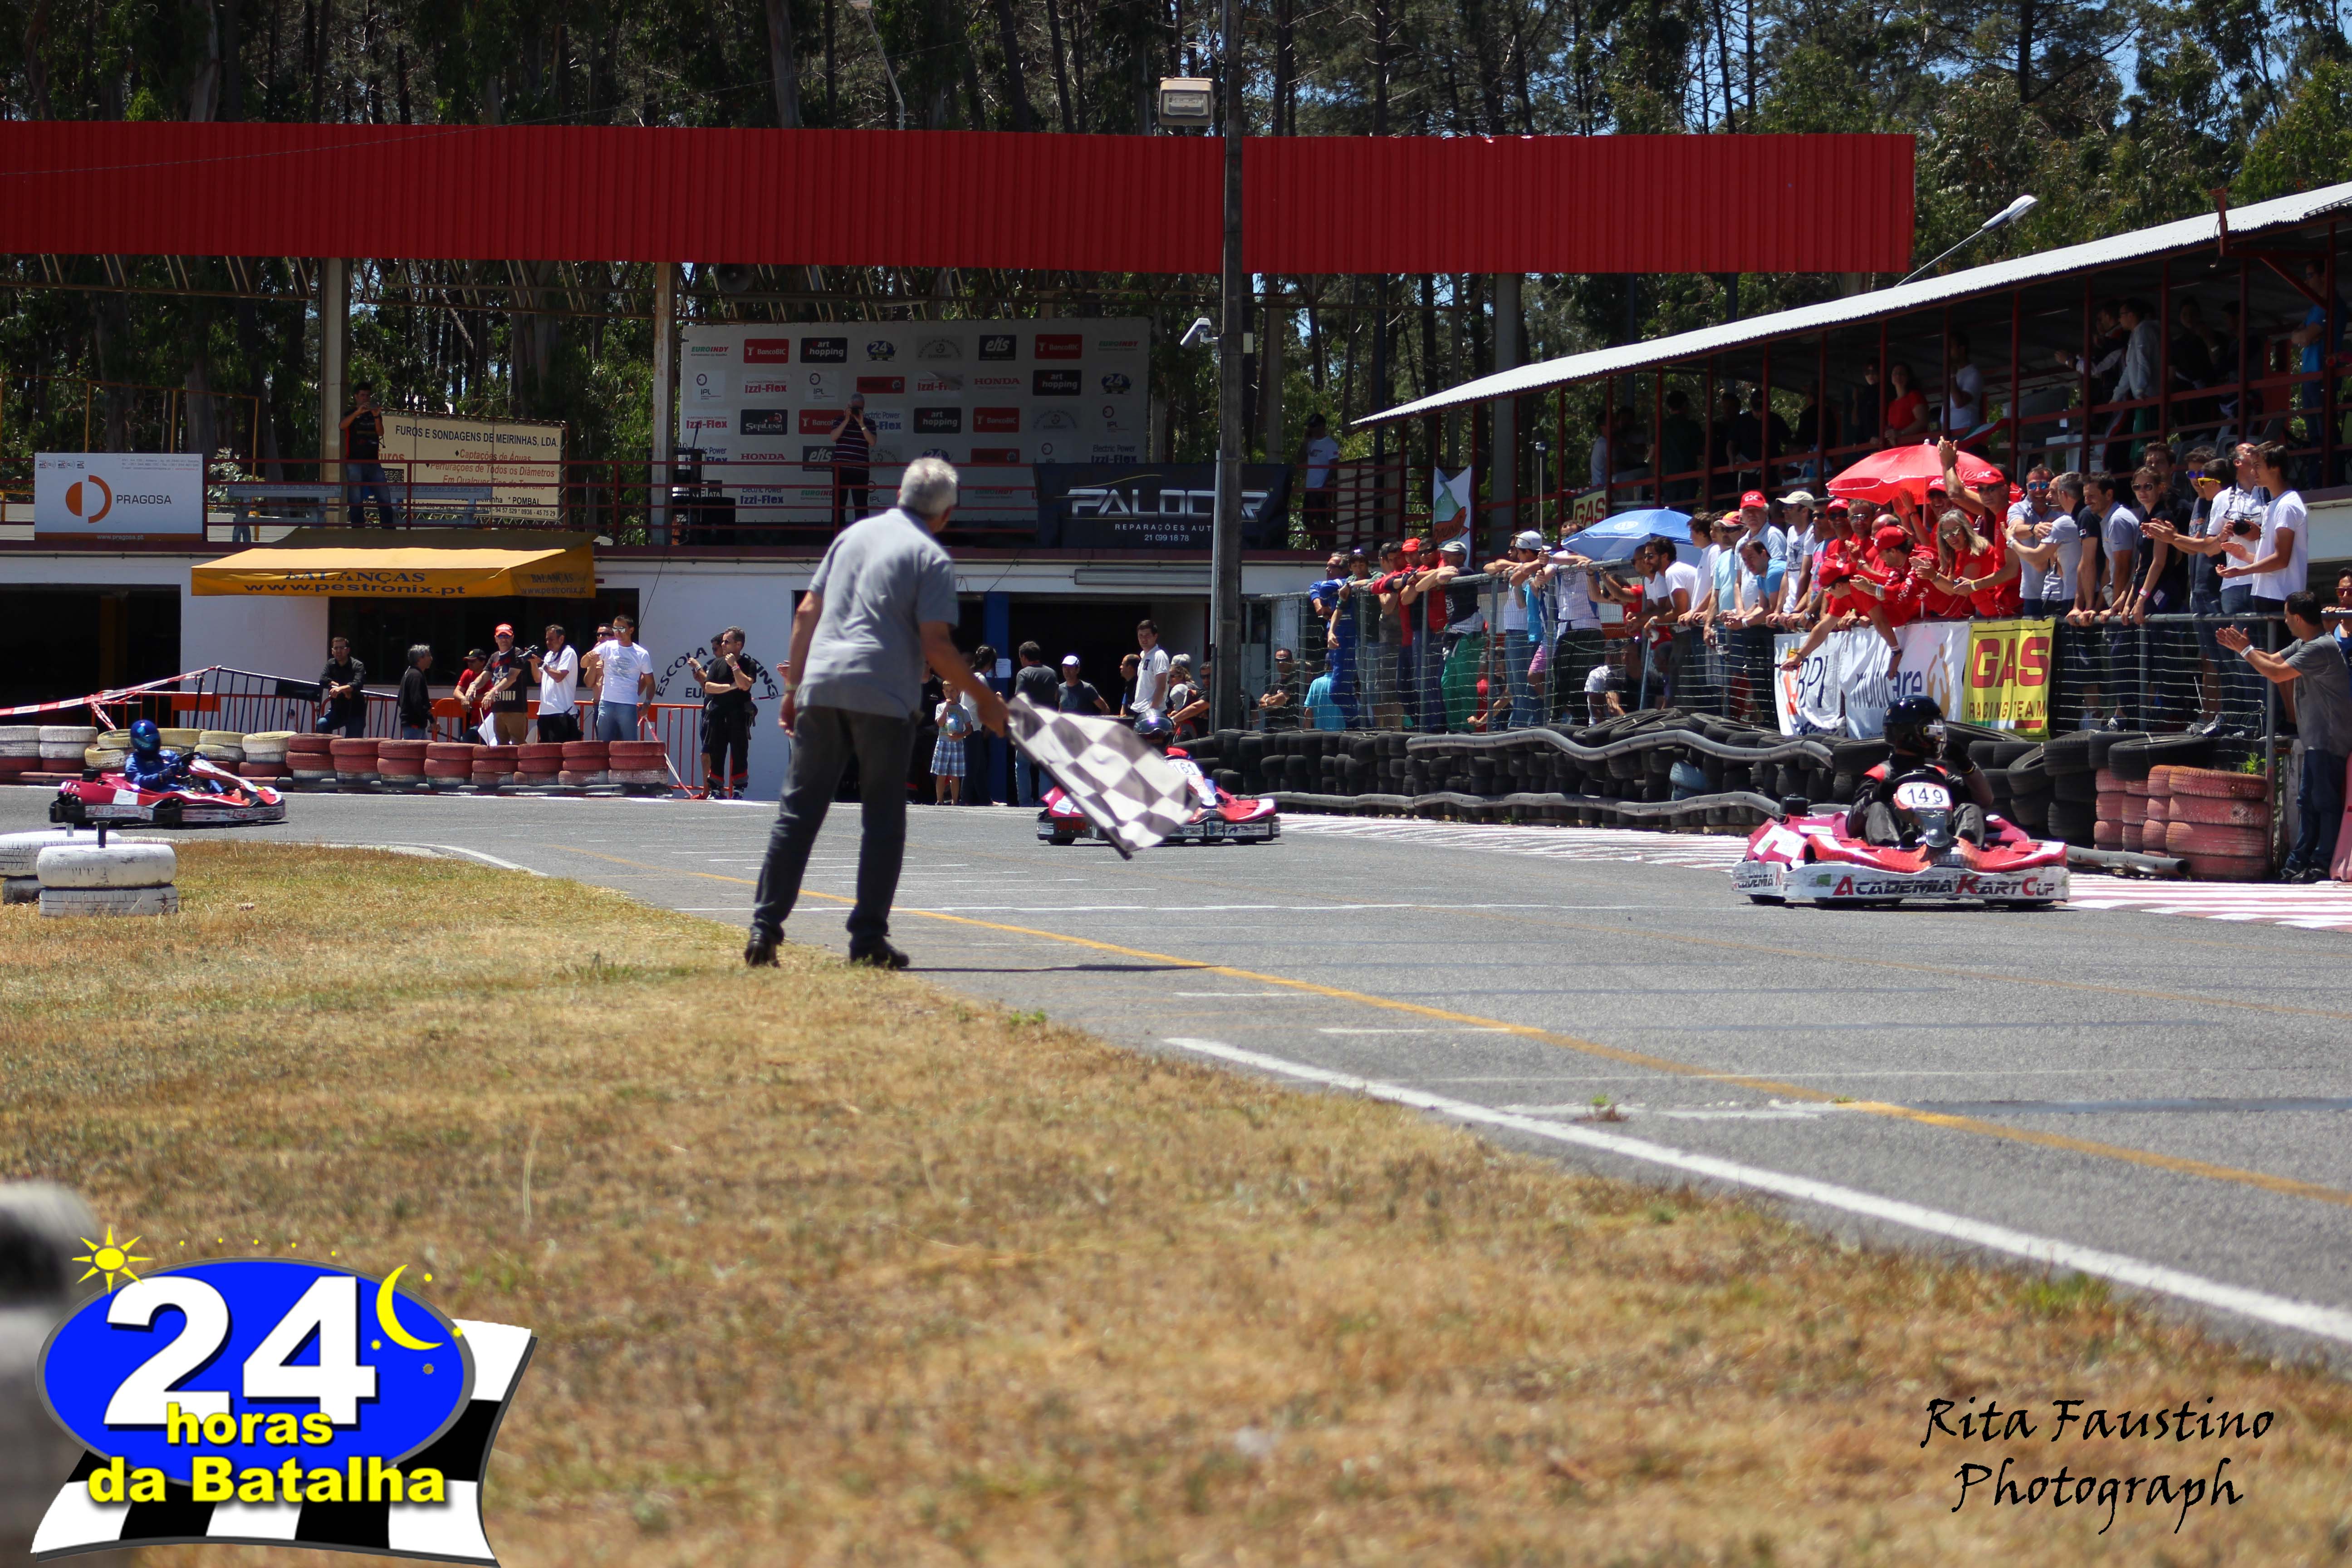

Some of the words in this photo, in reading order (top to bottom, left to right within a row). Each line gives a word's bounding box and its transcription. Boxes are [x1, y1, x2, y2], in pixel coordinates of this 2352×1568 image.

[396, 425, 422, 437] FUROS
[426, 428, 430, 438] E
[432, 429, 481, 442] SONDAGENS
[484, 433, 494, 443] DE
[496, 433, 539, 447] MEIRINHAS,
[541, 437, 558, 447] LDA.
[460, 448, 497, 461] Captações
[499, 452, 507, 461] de
[509, 451, 531, 461] Águas
[475, 464, 484, 472] de
[486, 464, 507, 475] Todos
[519, 466, 554, 477] Diâmetros
[116, 495, 172, 505] PRAGOSA
[1068, 489, 1269, 519] PALOCR
[1575, 497, 1605, 528] GAS
[1114, 523, 1186, 532] REPARAÇÕES
[244, 583, 466, 596] www.pestronix.pt
[1971, 636, 2050, 689] GAS
[656, 647, 708, 697] ESCOLA
[1969, 701, 2009, 718] RACING
[2013, 700, 2046, 718] TEAM
[1173, 762, 1196, 775] 161
[1907, 787, 1943, 804] 149
